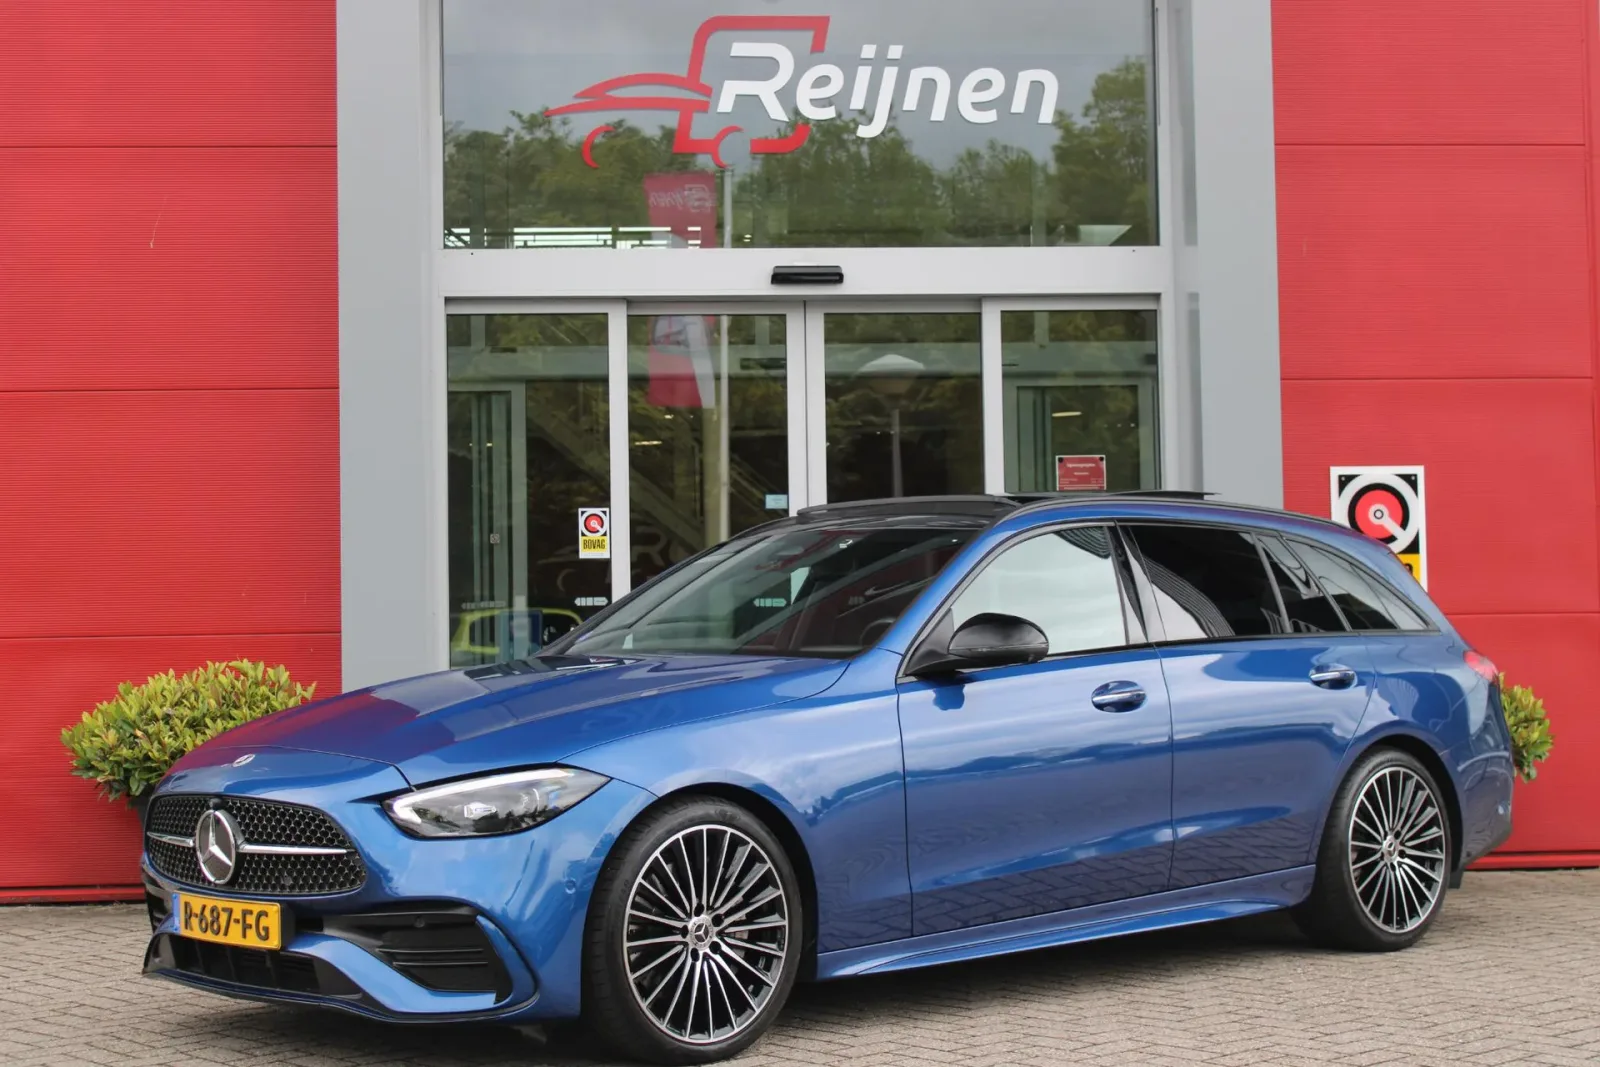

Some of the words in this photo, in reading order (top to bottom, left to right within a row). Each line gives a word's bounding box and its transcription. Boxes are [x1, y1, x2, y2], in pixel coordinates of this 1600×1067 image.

[717, 41, 1059, 138] Reijnen
[583, 538, 606, 550] BOVAG
[184, 902, 270, 942] R-687-FG
